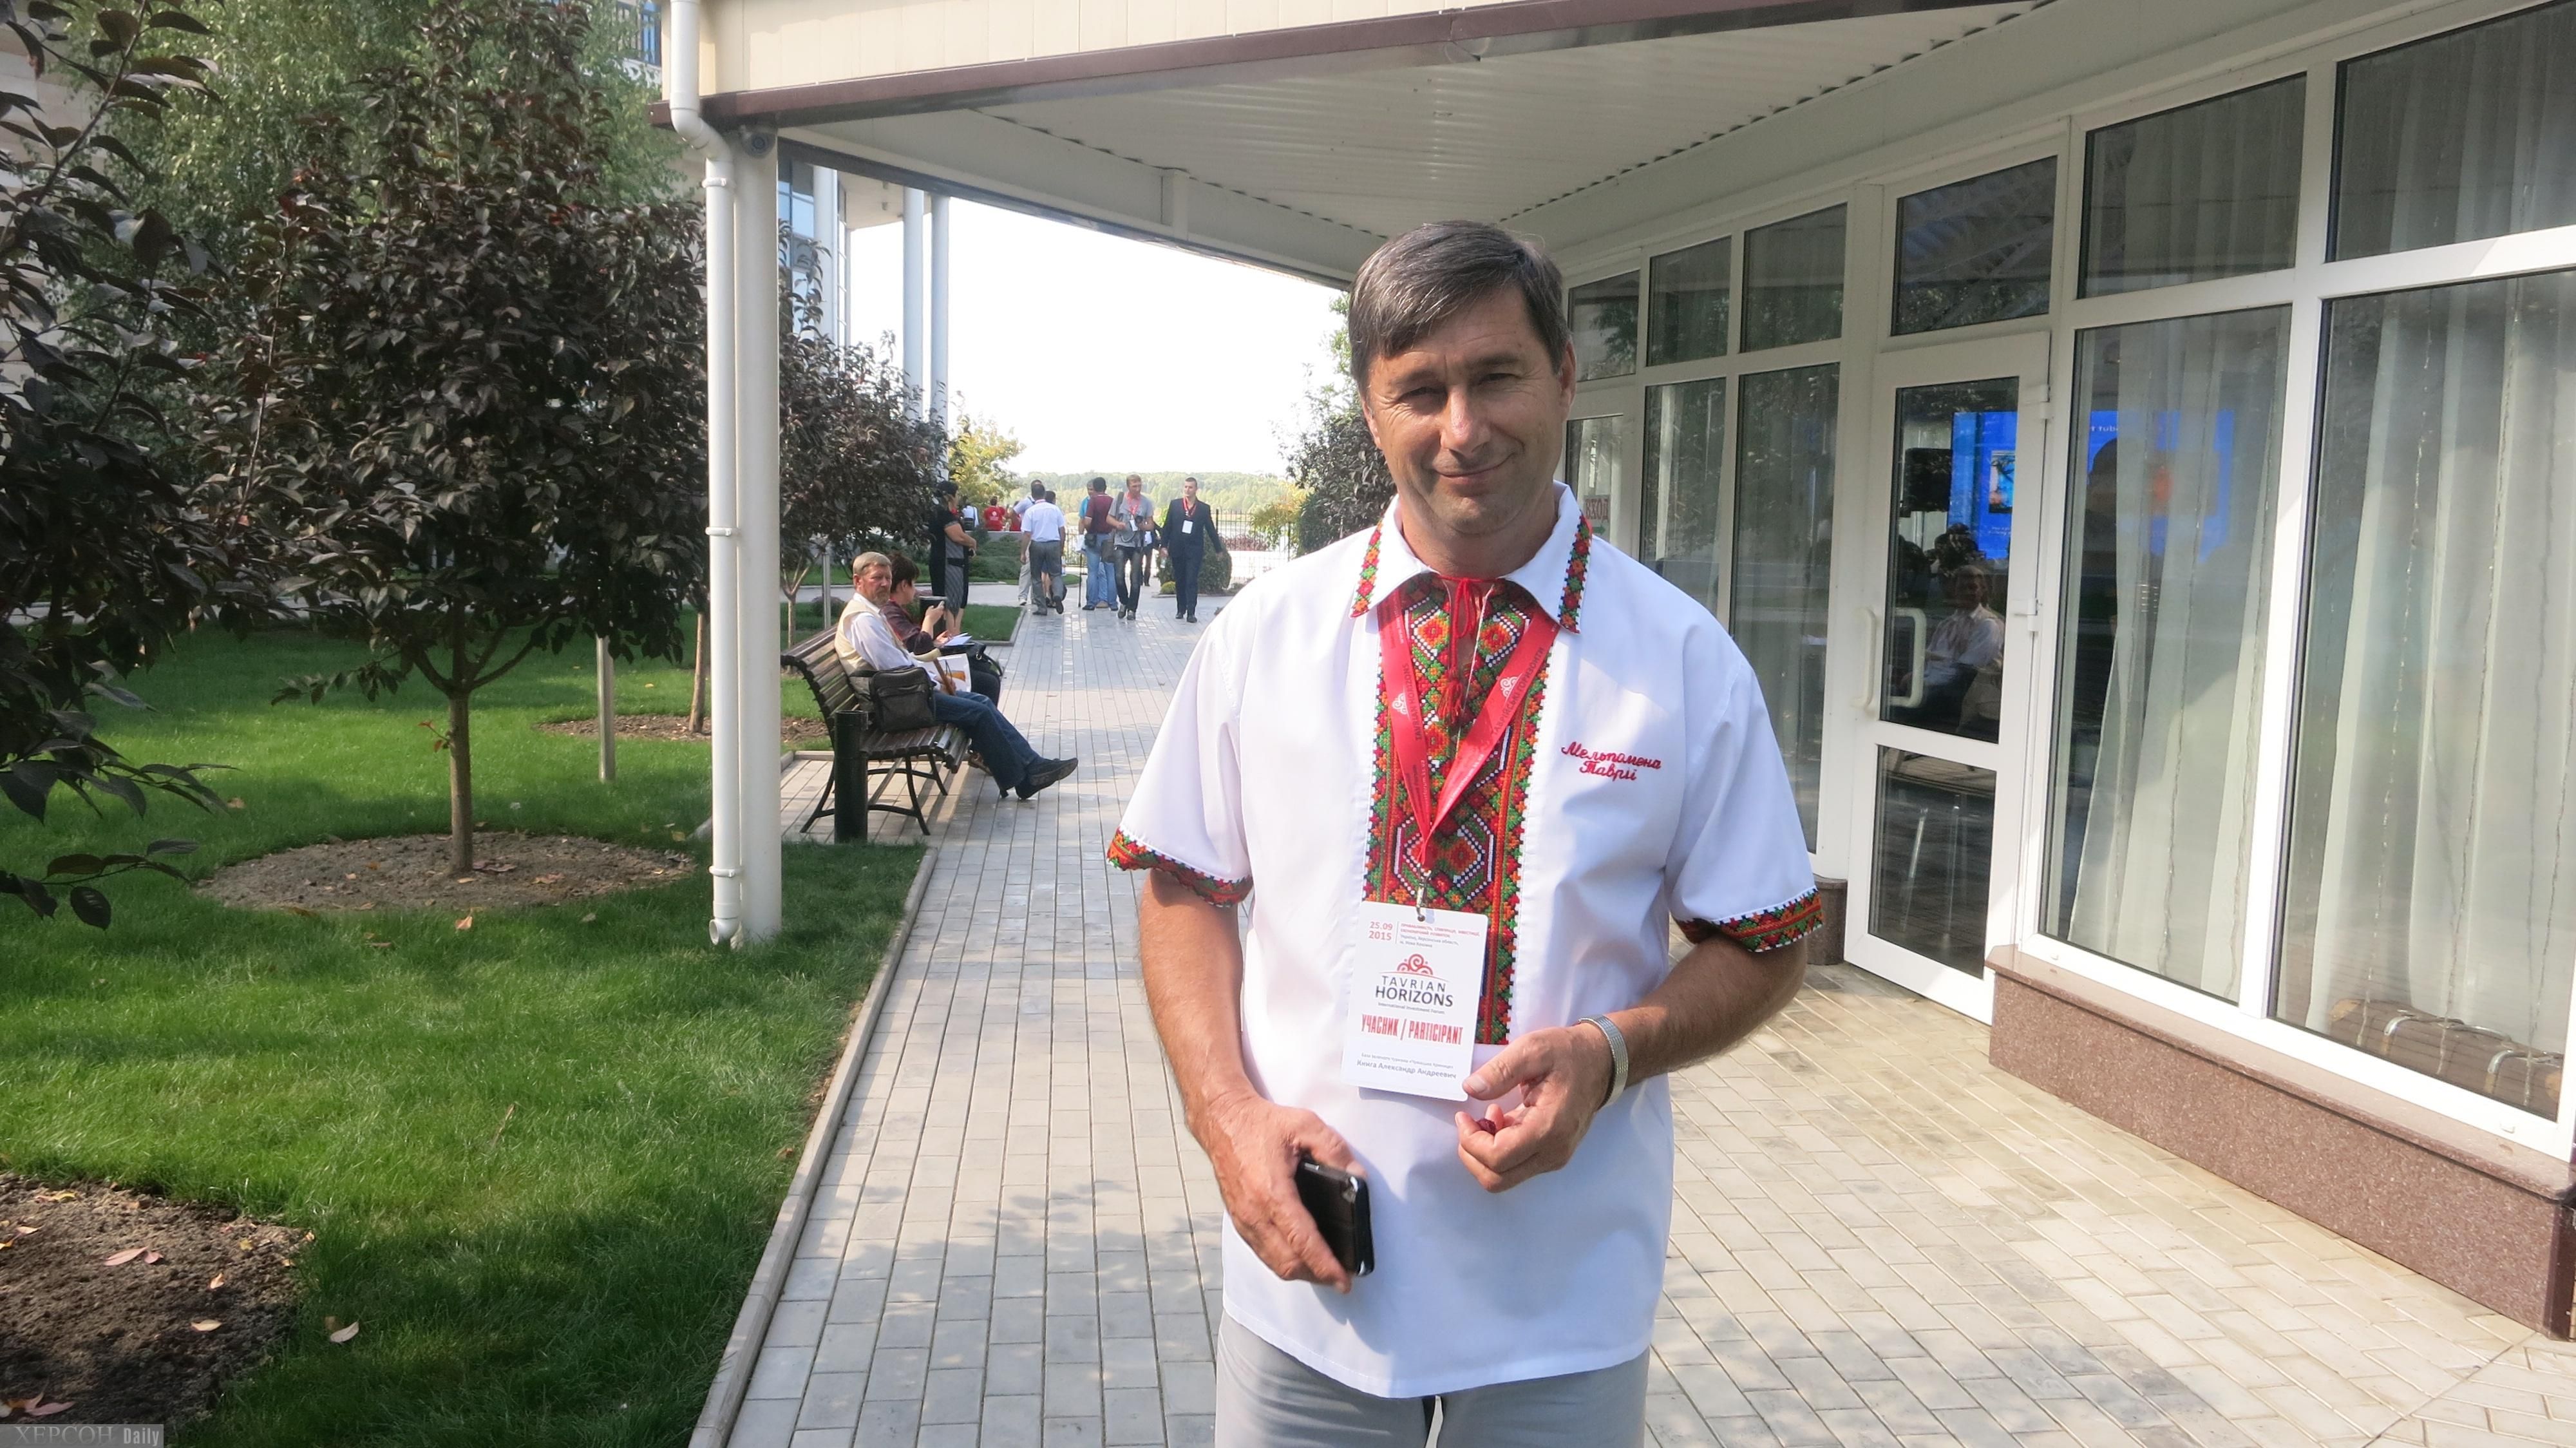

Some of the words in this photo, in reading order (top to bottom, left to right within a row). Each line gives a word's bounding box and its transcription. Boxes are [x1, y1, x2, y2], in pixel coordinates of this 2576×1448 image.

[1517, 647, 1544, 694] ГОРИЗОНТИ
[1403, 663, 1415, 704] HORIZONS
[1411, 705, 1422, 739] TAVRIAN
[1368, 931, 1392, 940] 2015
[1370, 921, 1393, 931] 25.09
[1382, 975, 1446, 992] TAVRIAN
[1376, 986, 1454, 1007] HORIZONS
[1361, 1014, 1399, 1036] УЧАСНИК
[1408, 1020, 1463, 1045] PARTICIPANT
[1357, 1060, 1377, 1068] Книга
[1378, 1062, 1416, 1074] Александр
[1417, 1068, 1457, 1079] Андреевич
